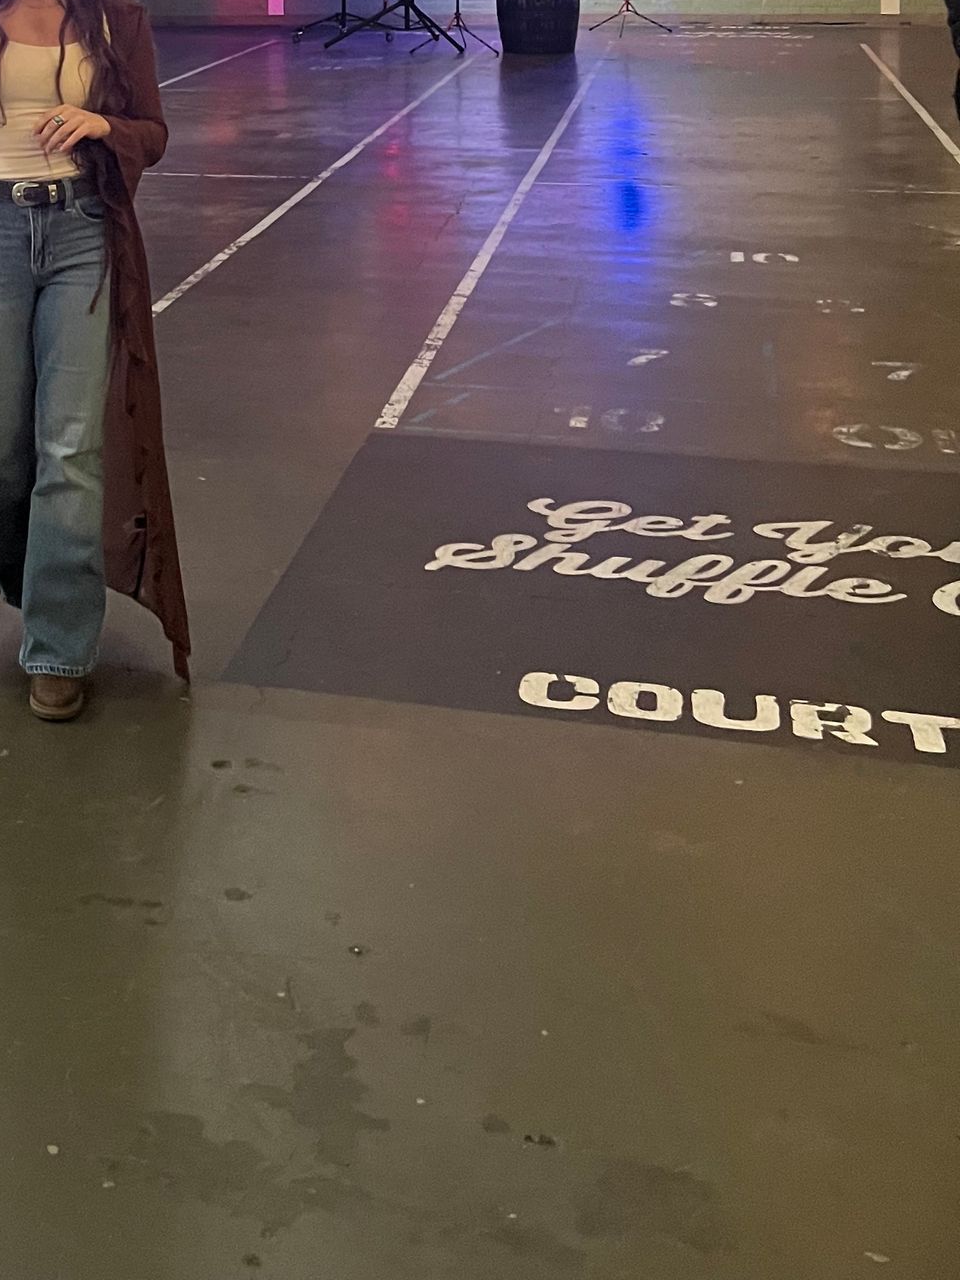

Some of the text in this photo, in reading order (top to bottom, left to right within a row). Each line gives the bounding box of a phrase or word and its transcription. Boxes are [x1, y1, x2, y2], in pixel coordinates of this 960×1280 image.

[527, 497, 735, 543] Get
[424, 533, 908, 604] Shuffle
[518, 671, 960, 754] COURT
